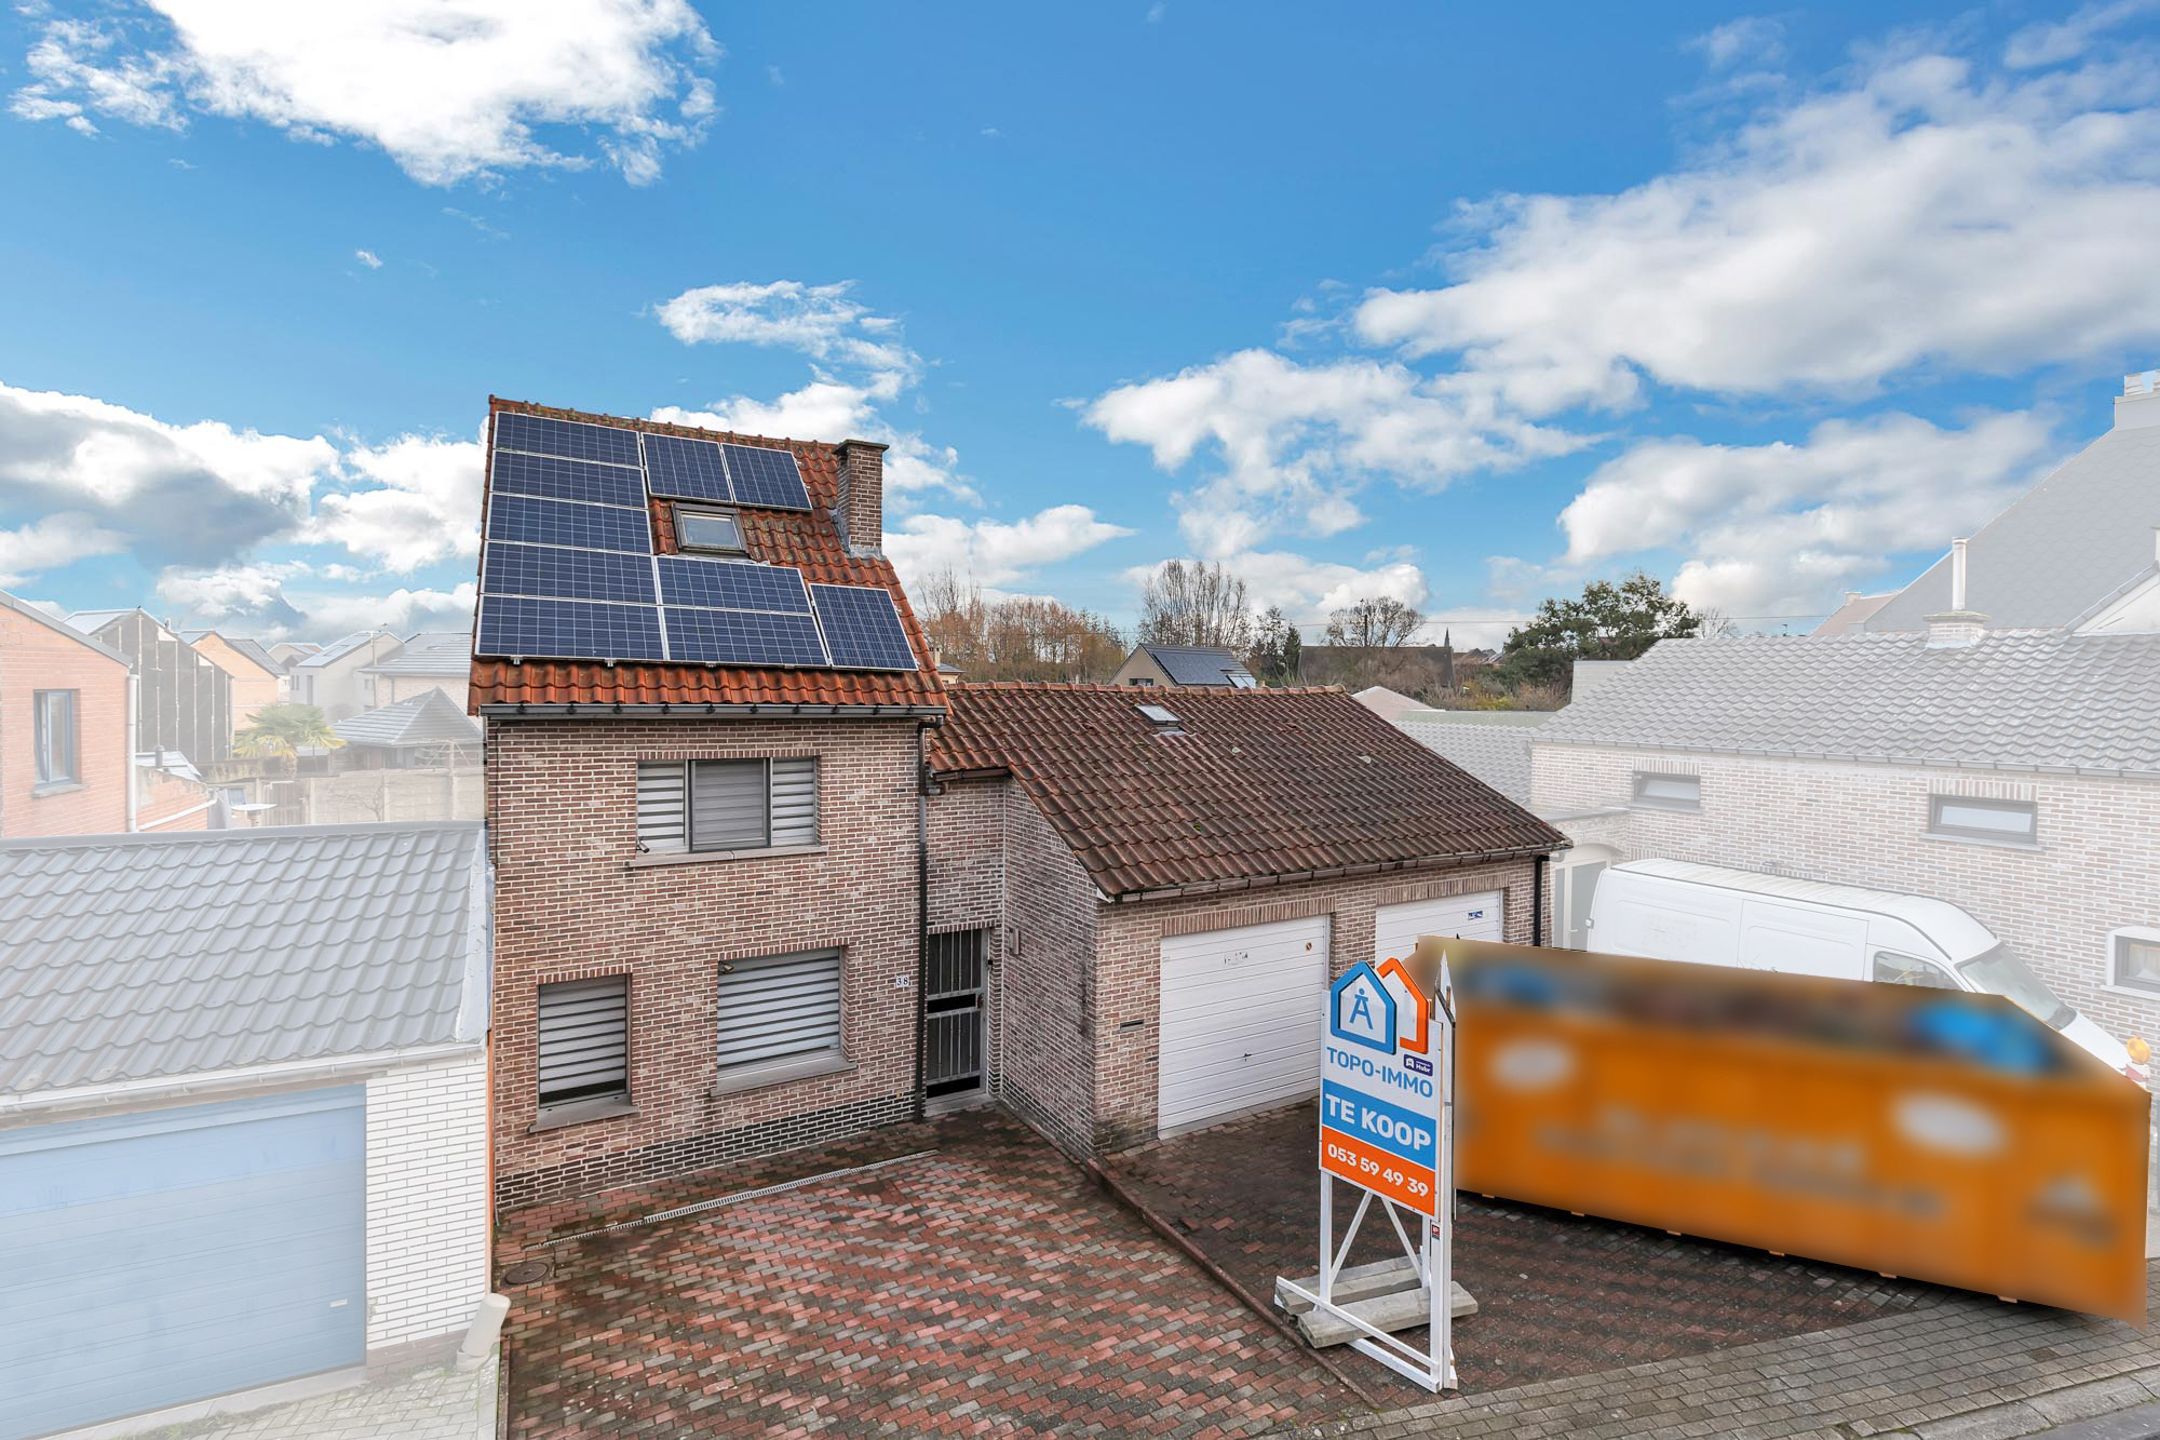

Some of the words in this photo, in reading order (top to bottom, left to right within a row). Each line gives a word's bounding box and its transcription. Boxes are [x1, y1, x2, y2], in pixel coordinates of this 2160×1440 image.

[1327, 1047, 1433, 1098] TOPO-IMMO
[1325, 1093, 1355, 1125] TE
[1361, 1107, 1432, 1151] KOOP
[1327, 1143, 1357, 1167] 053
[1360, 1156, 1380, 1176] 59
[1382, 1168, 1404, 1186] 49
[1406, 1177, 1429, 1197] 39
